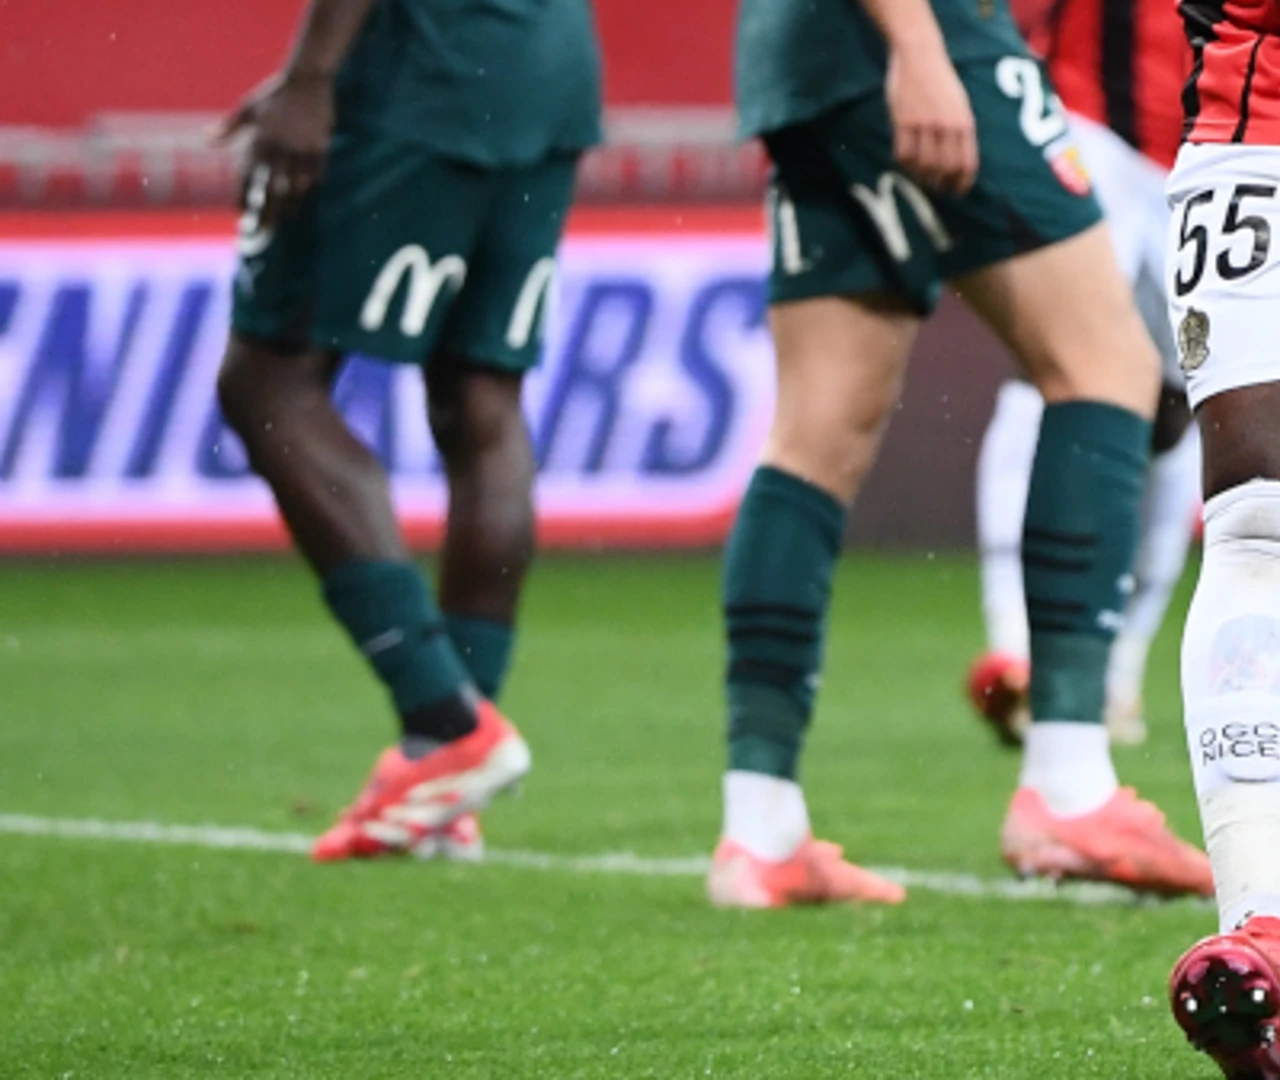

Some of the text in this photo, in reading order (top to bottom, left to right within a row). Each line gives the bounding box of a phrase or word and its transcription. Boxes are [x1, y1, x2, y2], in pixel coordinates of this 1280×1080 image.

[995, 56, 1066, 147] 2
[1175, 183, 1277, 297] 55
[1199, 721, 1280, 748] OGC
[1202, 740, 1280, 767] NICE
